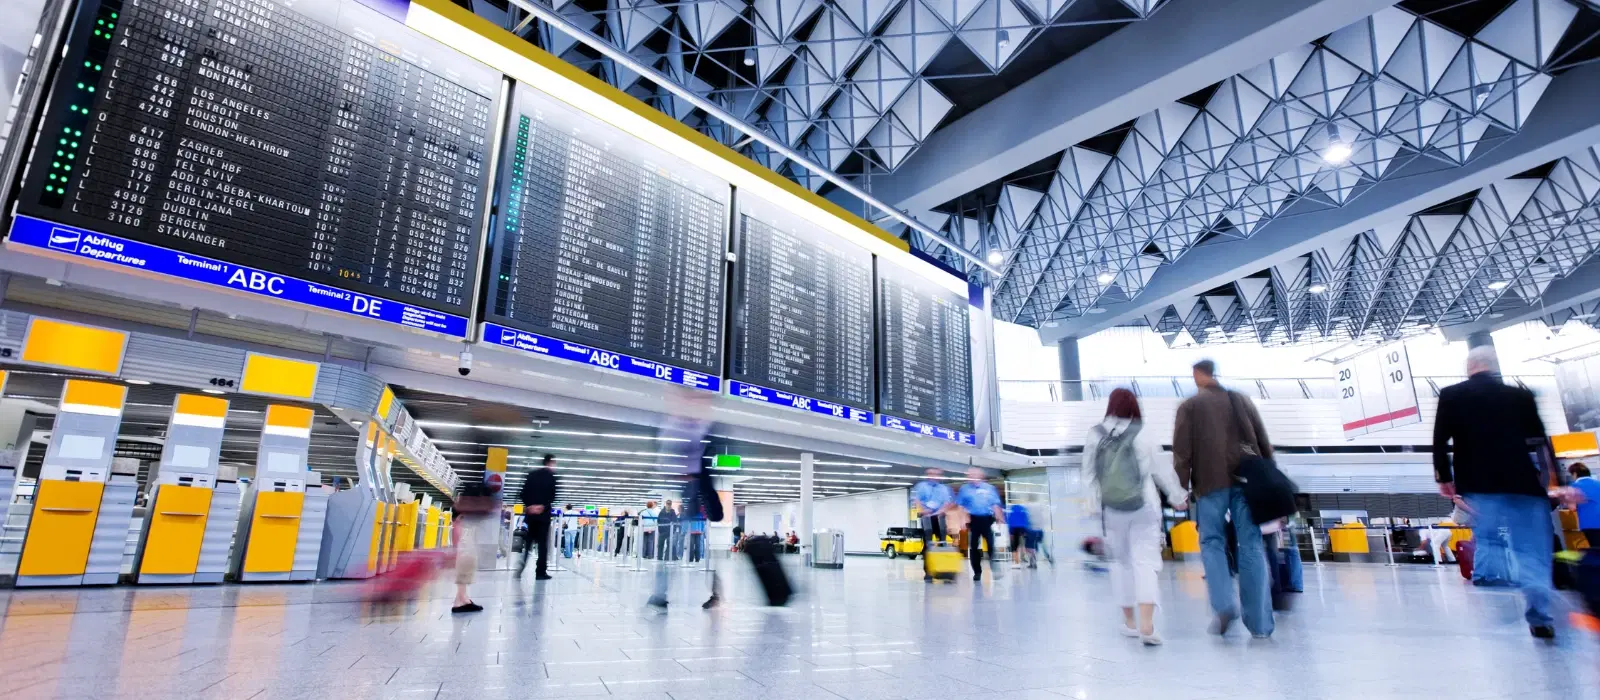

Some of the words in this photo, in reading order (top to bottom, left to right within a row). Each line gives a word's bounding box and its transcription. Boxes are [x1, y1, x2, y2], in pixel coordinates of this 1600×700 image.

[164, 10, 194, 28] 3236
[120, 37, 129, 47] A
[160, 52, 183, 67] 875
[198, 66, 255, 94] MONTREAL
[123, 27, 132, 37] L
[163, 42, 186, 57] 494
[200, 57, 250, 82] CALGARY
[108, 79, 117, 89] L
[149, 93, 172, 108] 440
[187, 106, 238, 130] HOUSTON
[111, 69, 120, 78] L
[152, 83, 175, 97] 442
[190, 96, 241, 120] DETROIT
[114, 58, 123, 68] L
[155, 73, 178, 87] 456
[192, 86, 215, 100] LOS
[221, 97, 270, 120] ANGELES
[105, 90, 113, 99] L
[138, 101, 170, 118] 4726
[184, 117, 289, 158] LONDON-HEATHROW
[140, 125, 164, 139] 417
[179, 137, 224, 158] ZAGREB
[91, 133, 101, 143] L
[134, 146, 158, 160] 686
[173, 158, 197, 172] TEL
[204, 167, 233, 183] AVIV
[95, 122, 104, 132] L
[129, 133, 161, 150] 6808
[176, 148, 214, 166] KOELN
[221, 161, 243, 175] HBF
[78, 179, 87, 188] L
[113, 188, 147, 204] 4980
[162, 201, 209, 220] DUBLIN
[81, 167, 91, 177] J
[125, 179, 150, 193] 117
[165, 190, 233, 216] LJUBLJANA
[85, 156, 94, 166] L
[128, 168, 153, 182] 176
[168, 179, 256, 211] BERLIN-TEGEL
[88, 145, 97, 154] L
[131, 157, 155, 171] 590
[171, 169, 209, 187] ADDIS
[216, 182, 311, 216] ABEBA-KHARTOUM
[71, 202, 81, 212] L
[107, 211, 141, 226] 3160
[156, 223, 226, 247] STAVANGER
[75, 190, 84, 200] L
[110, 199, 144, 215] 3126
[159, 212, 206, 231] BERGEN
[80, 245, 146, 266] Departures
[83, 235, 124, 251] Abflug
[177, 255, 221, 272] Terminal
[223, 265, 228, 273] 1
[227, 269, 285, 295] ABC
[308, 284, 345, 300] Terminal
[352, 296, 383, 317] DE
[516, 341, 549, 354] Departures
[517, 333, 538, 344] Abflug
[1385, 350, 1399, 365] 10
[563, 343, 586, 355] Terminal
[589, 350, 620, 369] ABC
[631, 359, 651, 369] Terminal
[655, 364, 673, 381] DE
[1339, 368, 1351, 382] 20
[1389, 369, 1403, 383] 10
[210, 377, 234, 388] 464
[1342, 386, 1355, 399] 20
[792, 396, 811, 410] ABC
[832, 405, 844, 417] DE
[920, 424, 934, 436] ABC
[947, 431, 955, 440] DE
